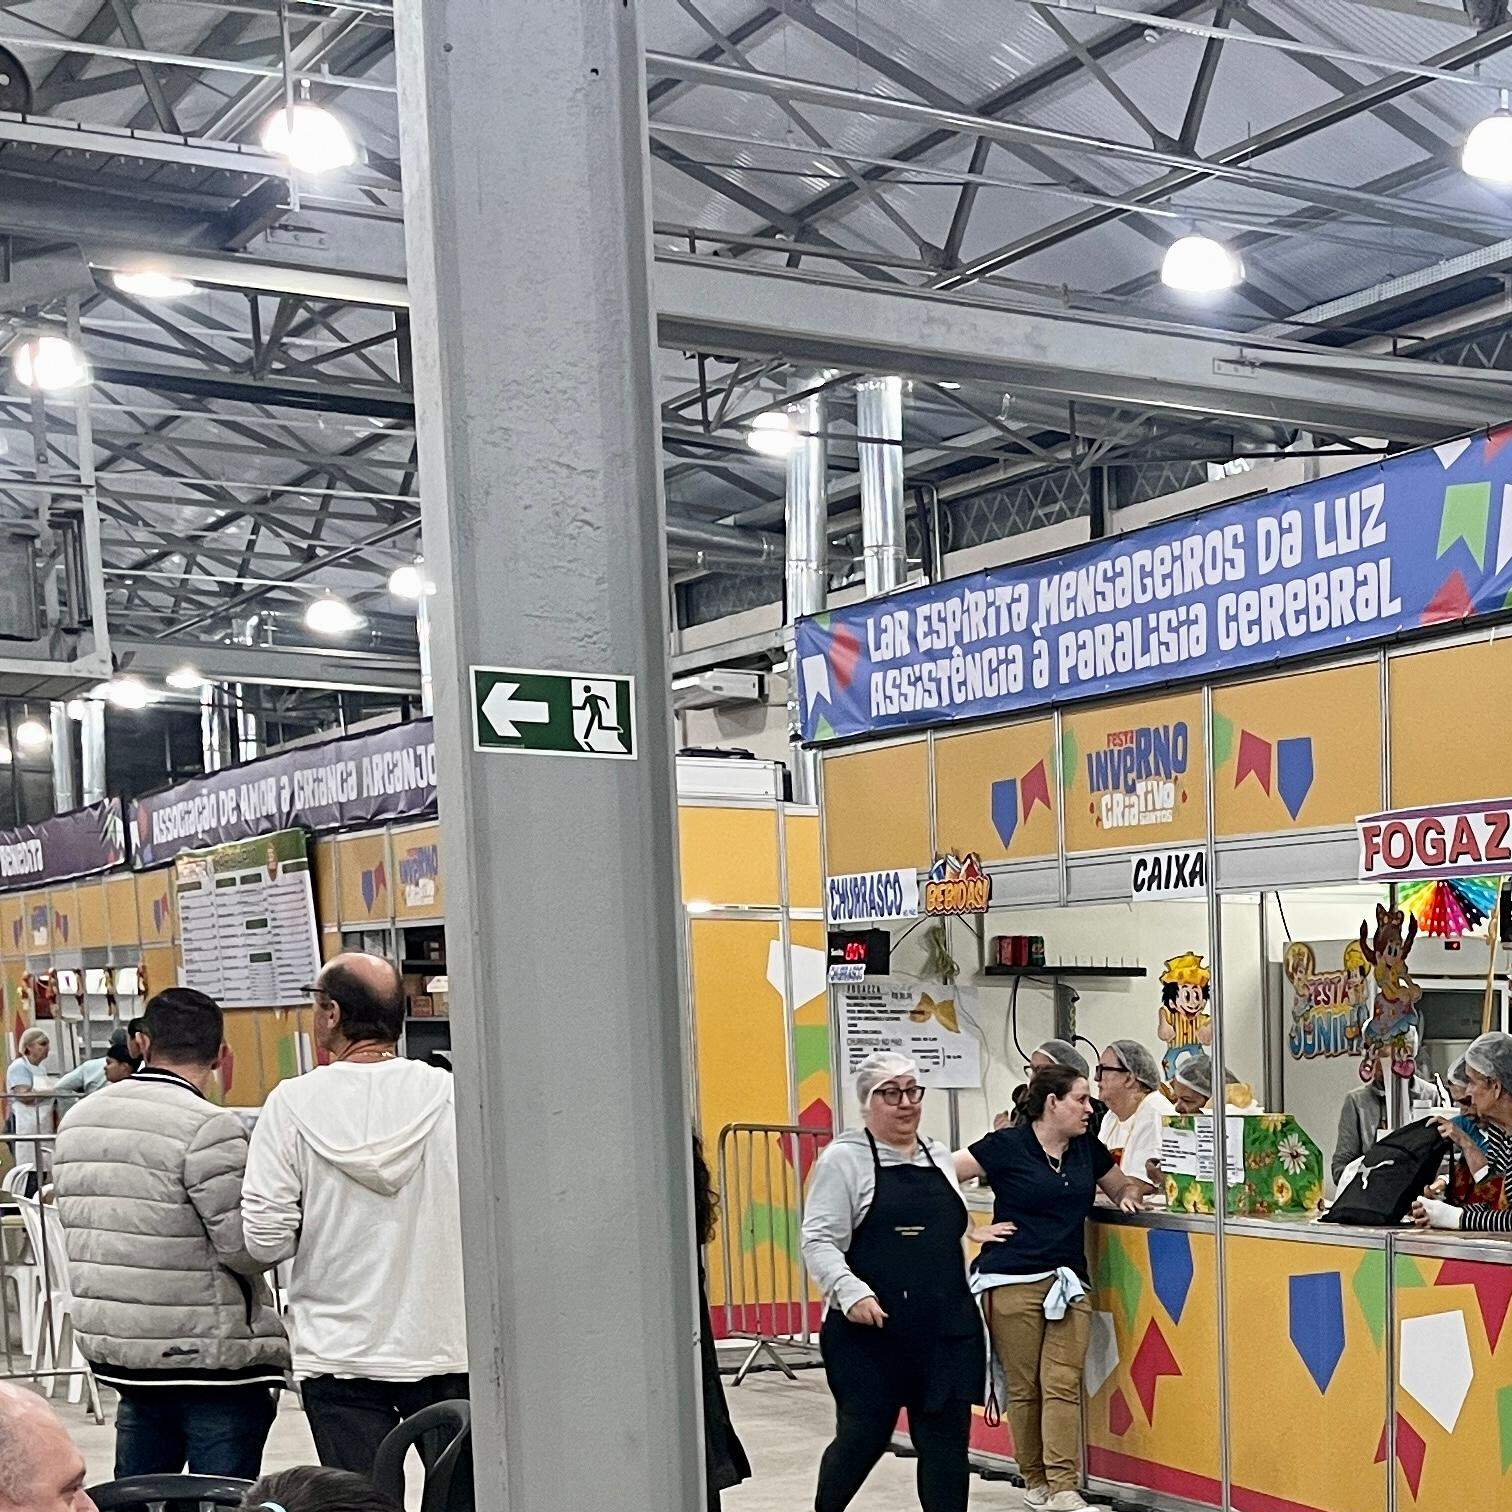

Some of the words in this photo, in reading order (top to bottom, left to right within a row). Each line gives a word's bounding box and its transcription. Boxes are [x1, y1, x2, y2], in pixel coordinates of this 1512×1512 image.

[1314, 483, 1387, 560] LUZ
[830, 872, 903, 920] CHURRASCO
[1133, 852, 1204, 892] CAIXA
